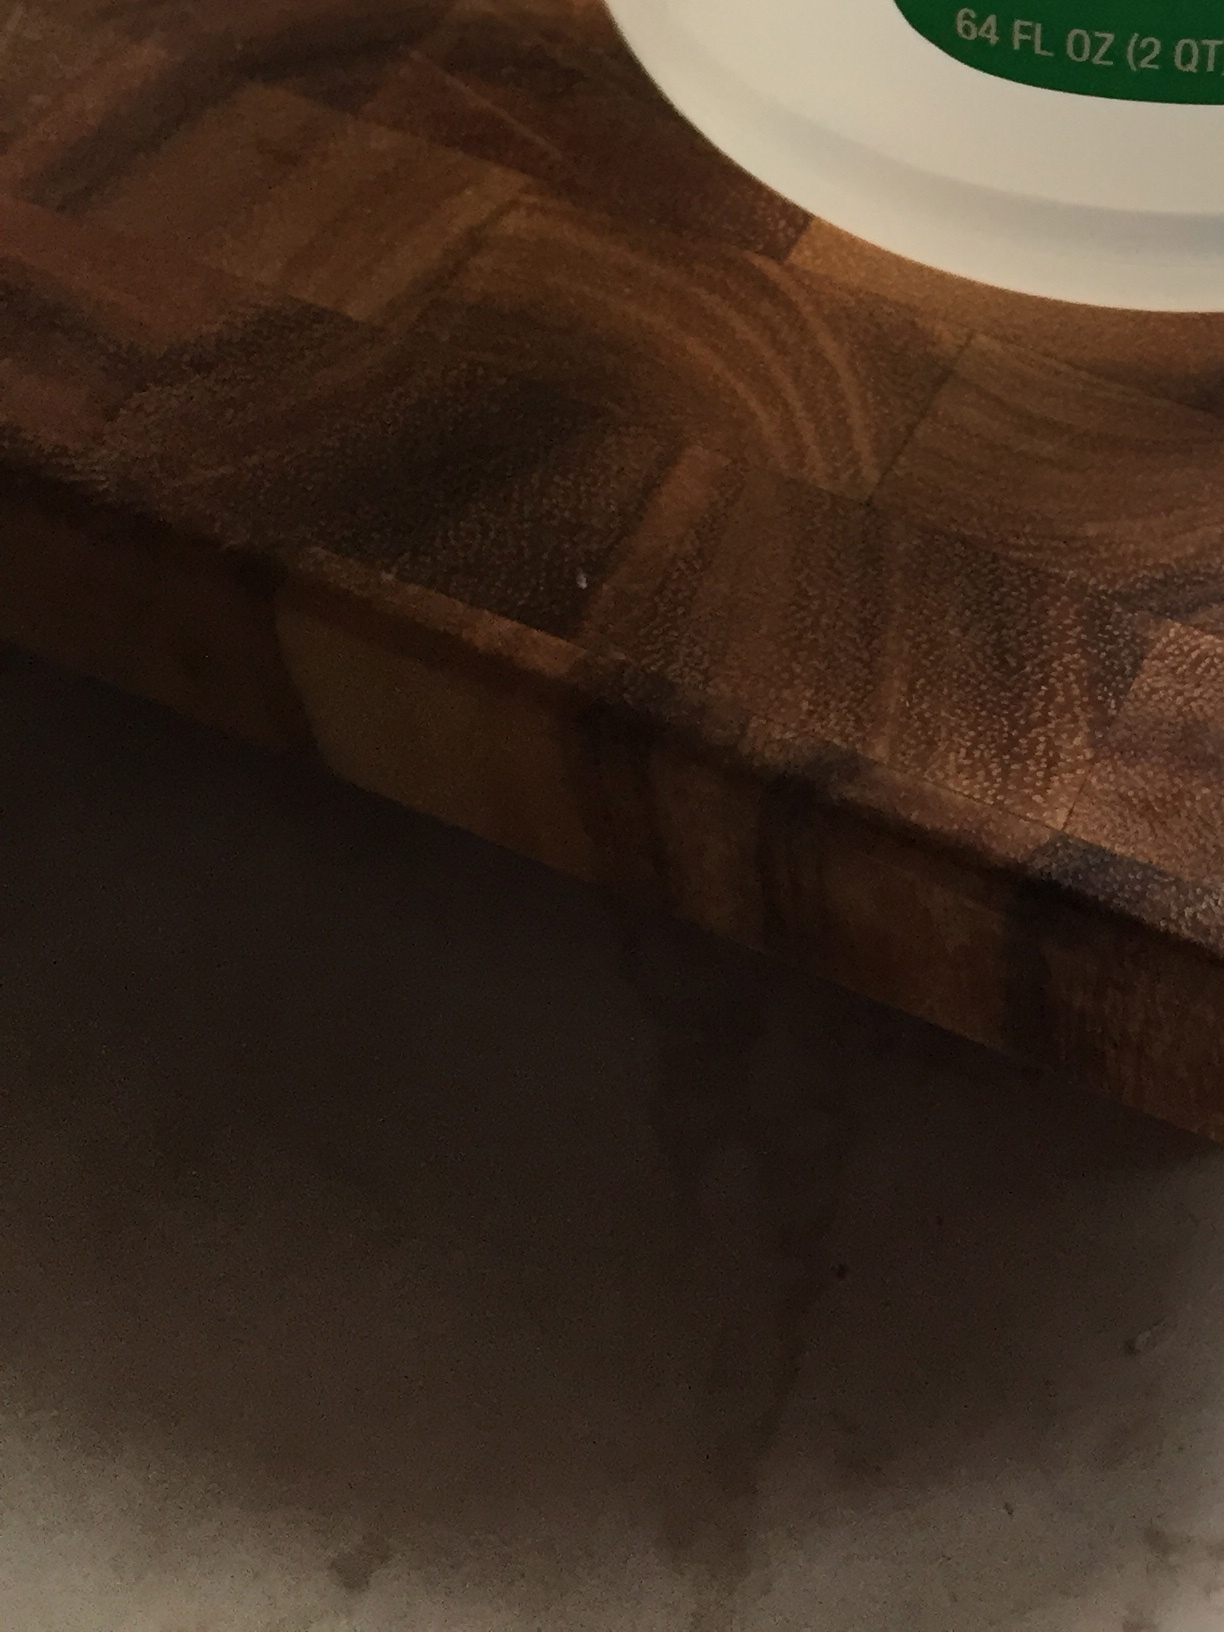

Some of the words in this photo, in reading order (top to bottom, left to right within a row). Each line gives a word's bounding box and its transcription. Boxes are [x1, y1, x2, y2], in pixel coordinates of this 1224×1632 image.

[955, 7, 999, 45] 64
[1012, 18, 1053, 58] FL
[1066, 29, 1115, 66] OZ
[1127, 32, 1162, 72] (2
